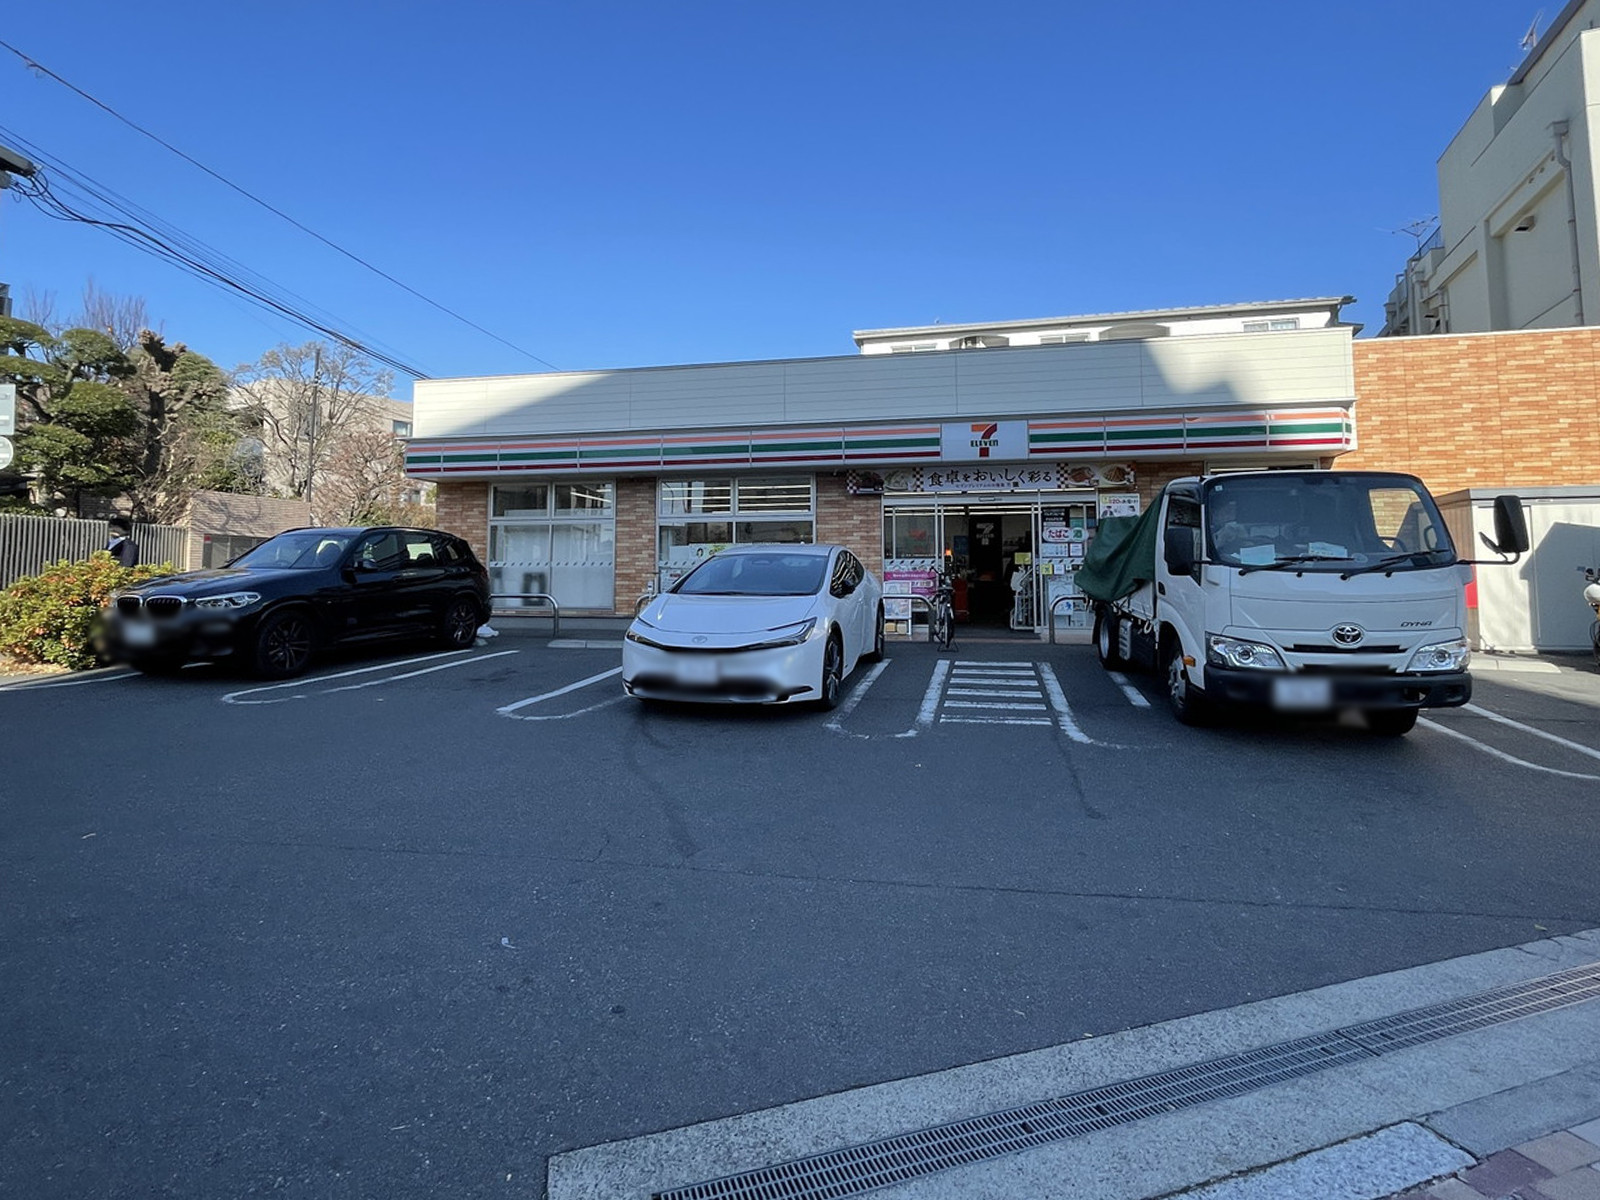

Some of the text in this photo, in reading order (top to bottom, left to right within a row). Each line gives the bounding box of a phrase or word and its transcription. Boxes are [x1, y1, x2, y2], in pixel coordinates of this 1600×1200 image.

[971, 422, 998, 457] 7
[928, 468, 1052, 487] 食卓をおいしく彩る
[1047, 529, 1070, 539] たばこ
